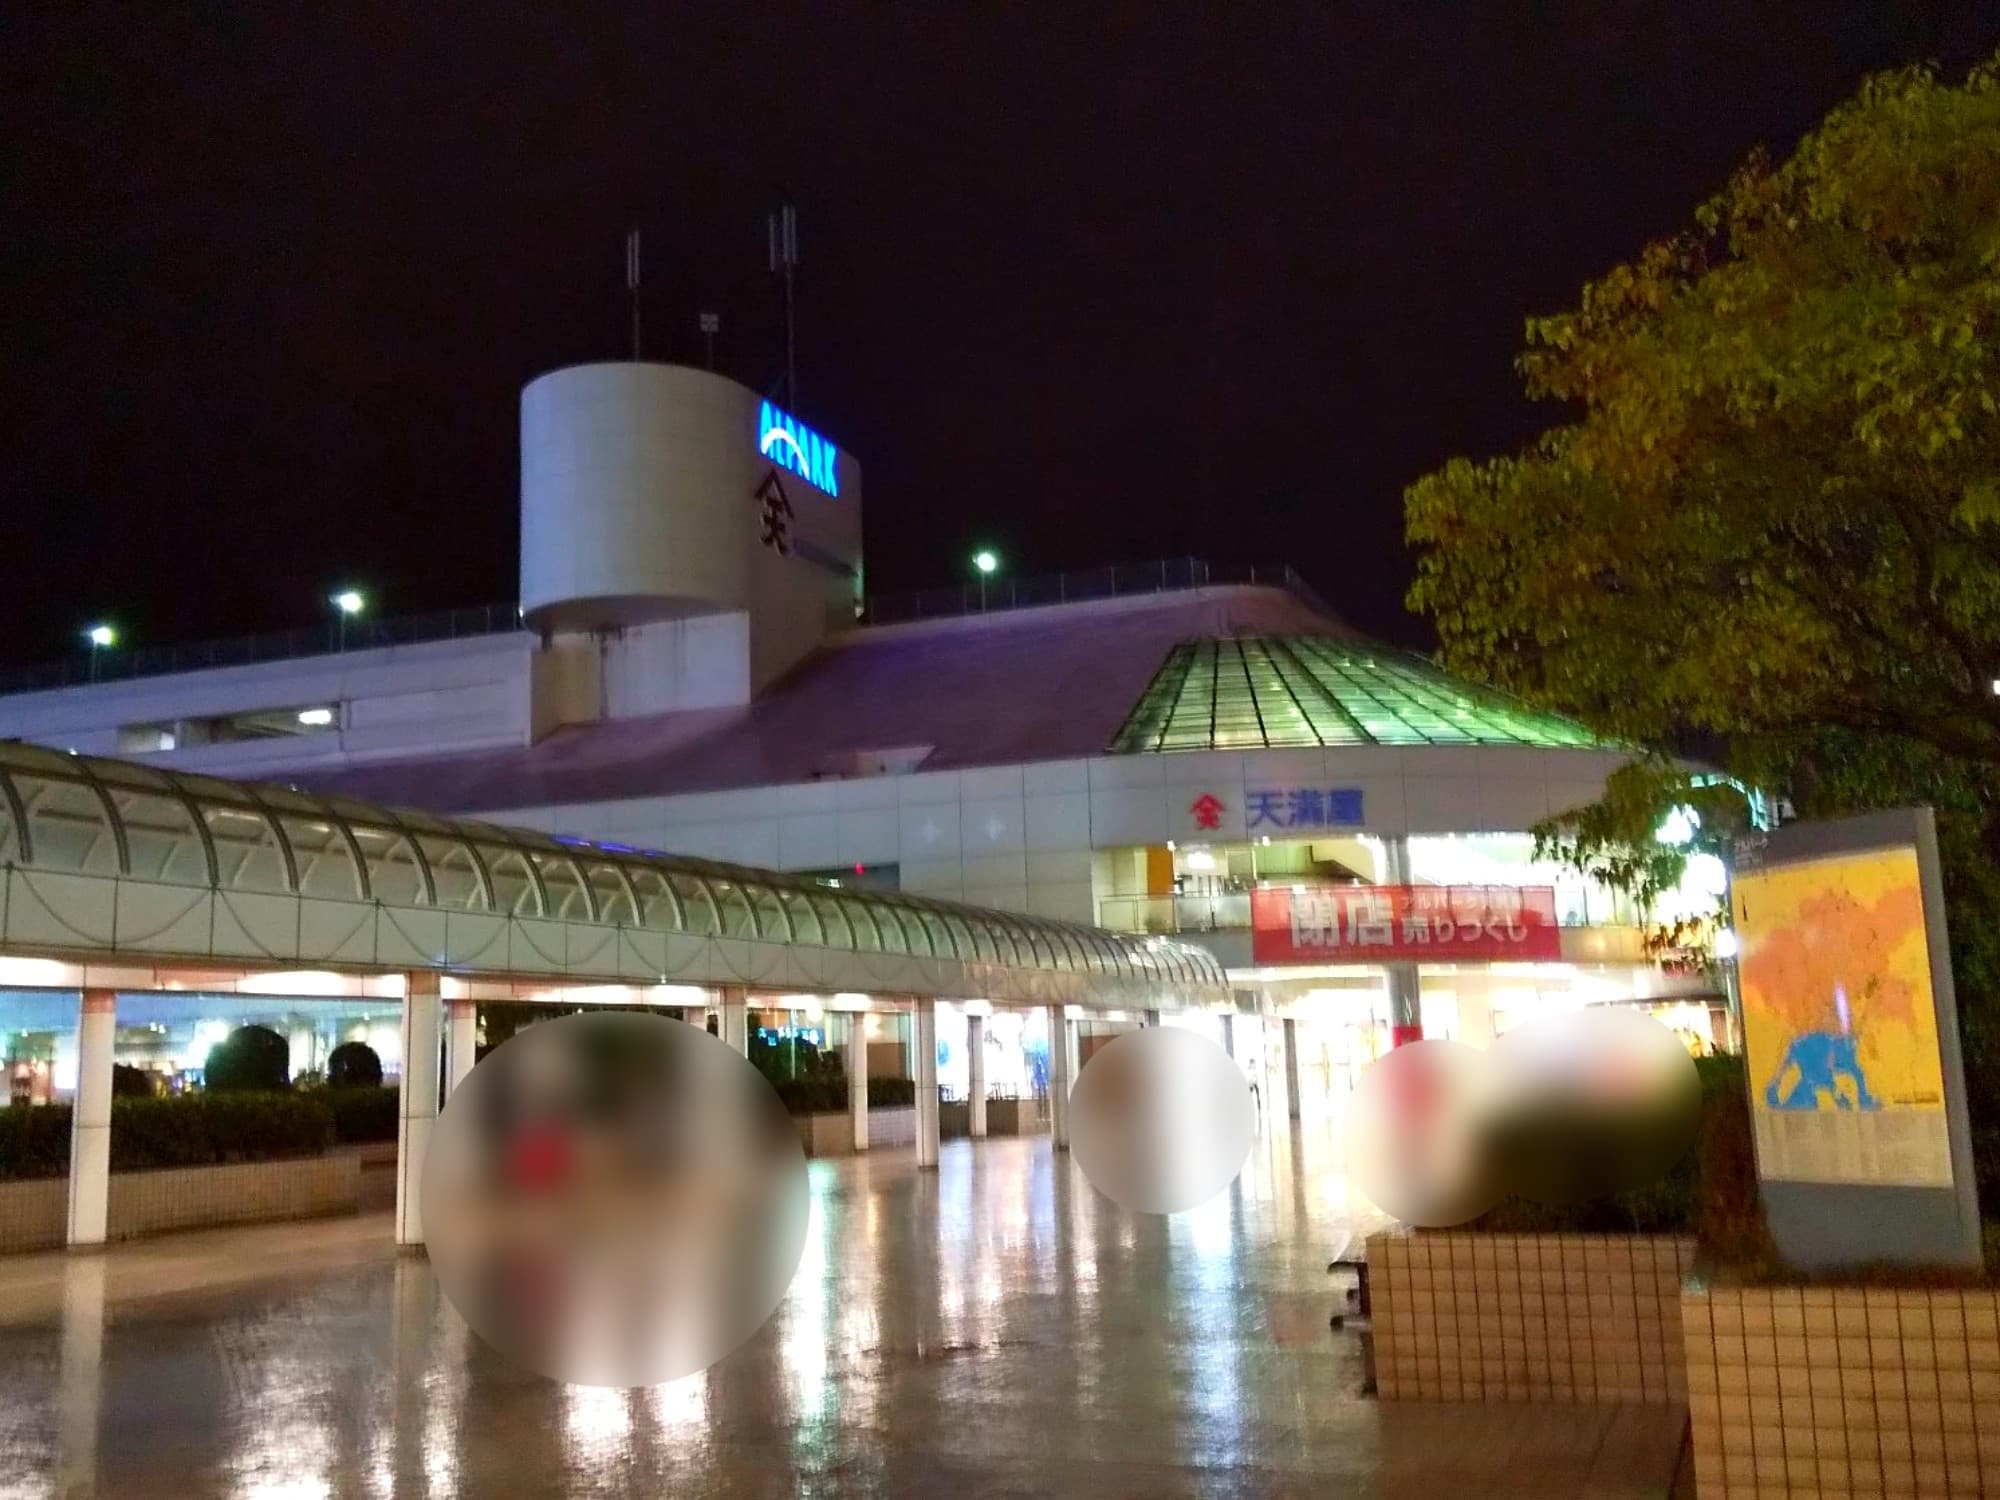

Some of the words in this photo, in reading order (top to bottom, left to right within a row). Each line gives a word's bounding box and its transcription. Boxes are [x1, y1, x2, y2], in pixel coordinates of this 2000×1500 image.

[760, 400, 838, 498] ALPARK
[1401, 912, 1528, 944] 売りつくし
